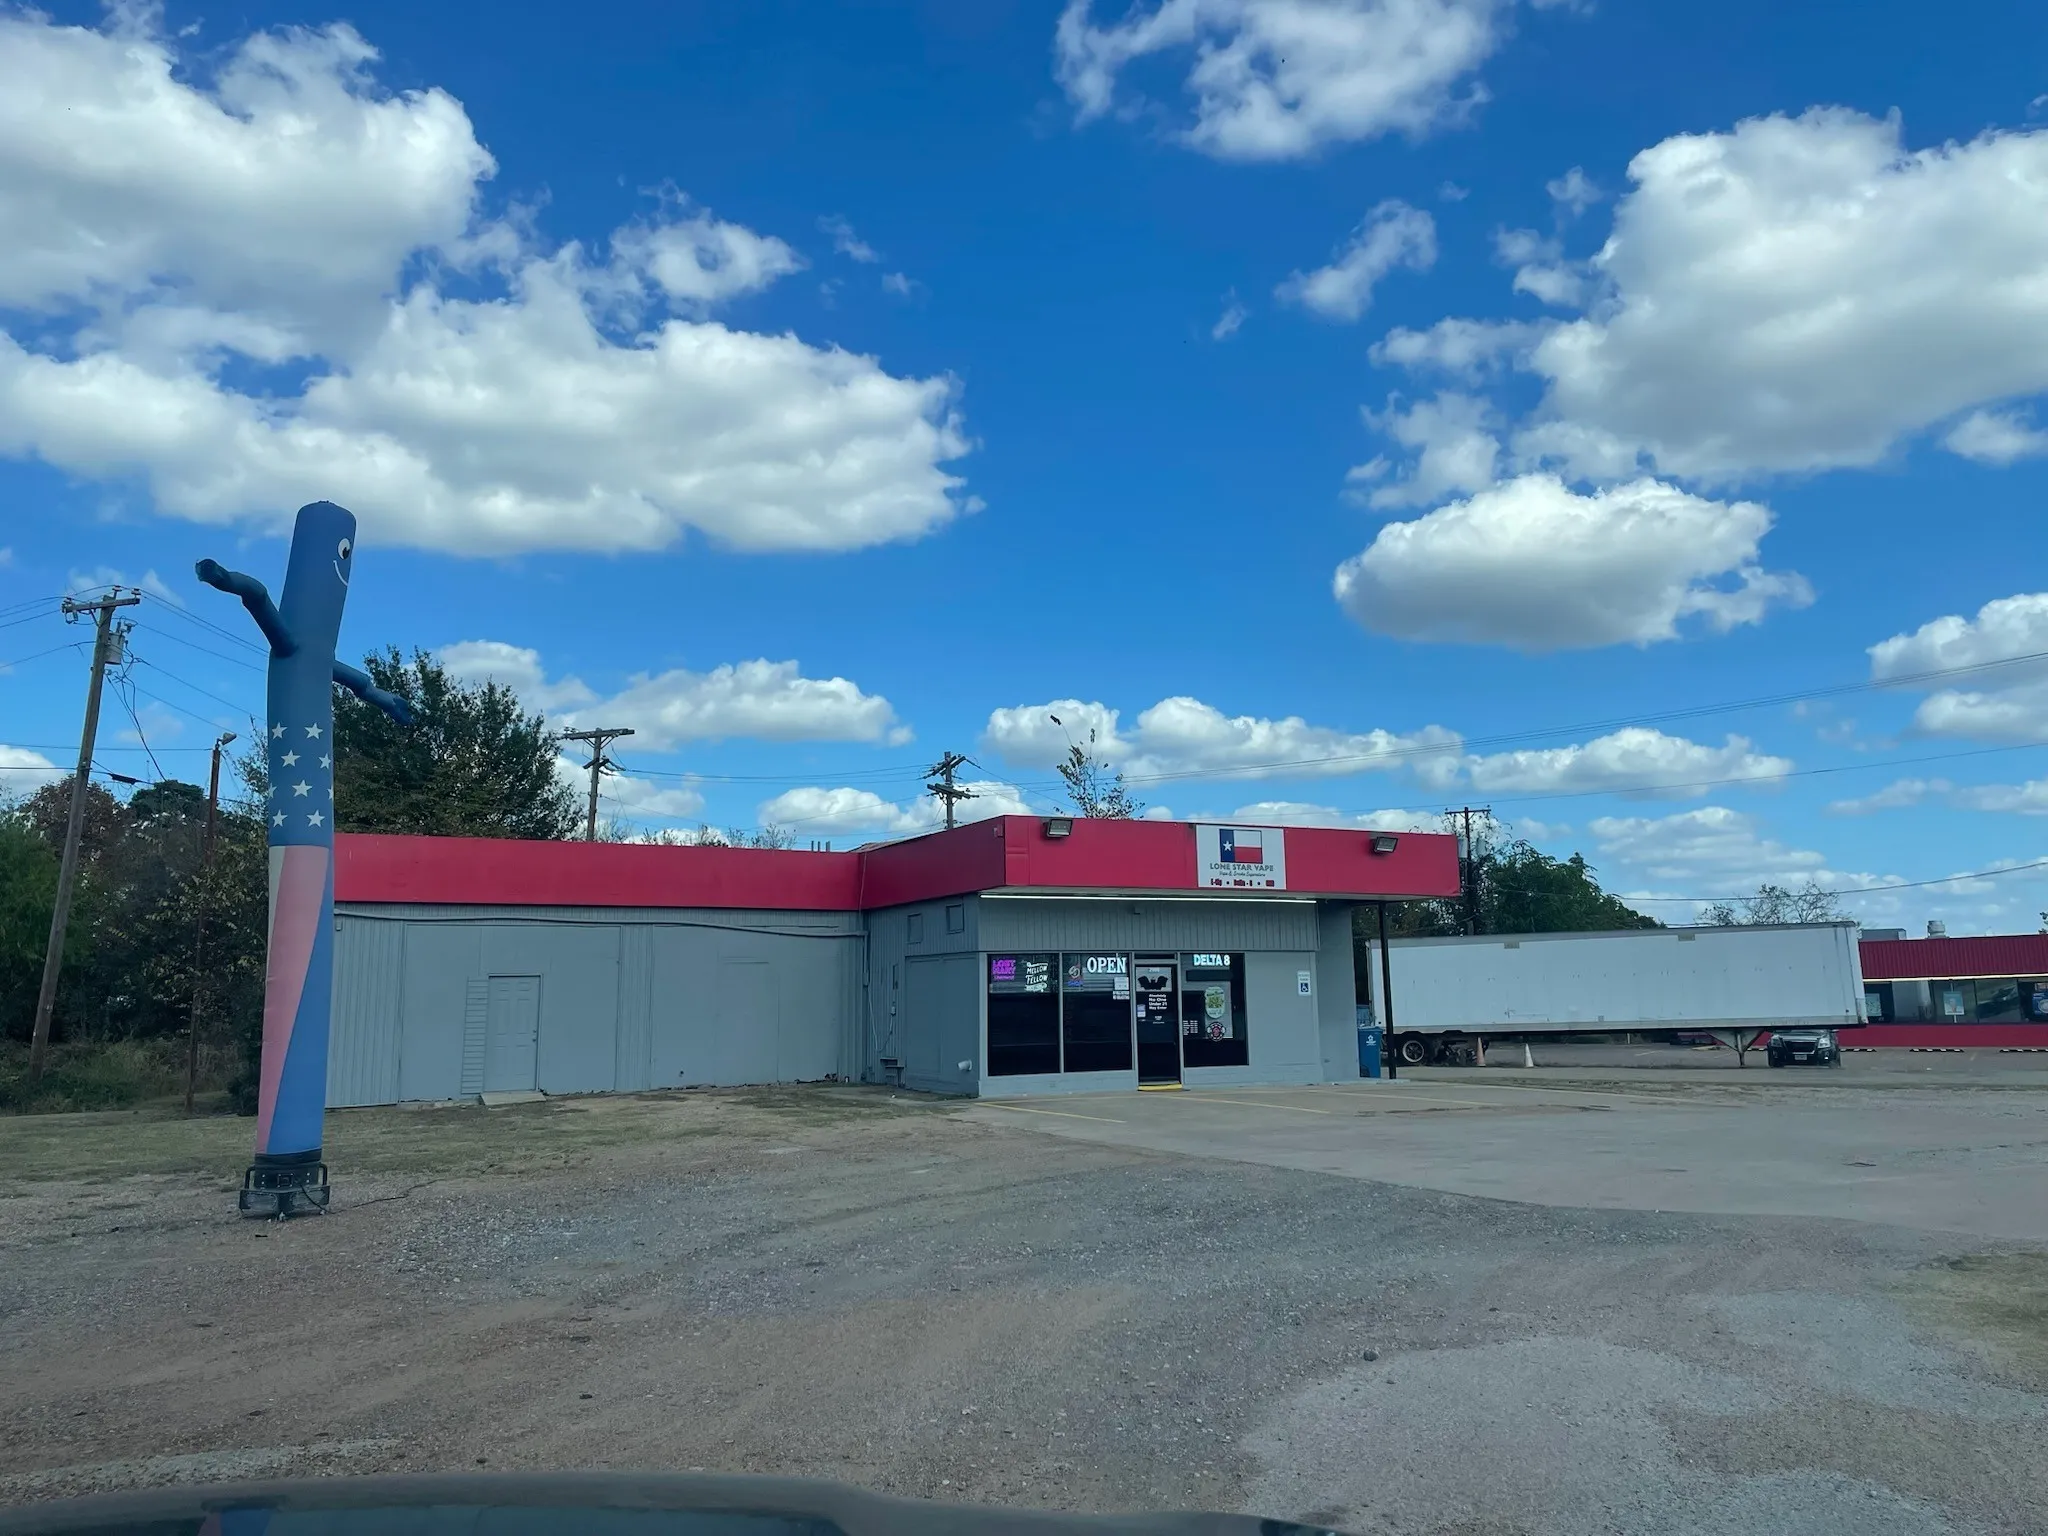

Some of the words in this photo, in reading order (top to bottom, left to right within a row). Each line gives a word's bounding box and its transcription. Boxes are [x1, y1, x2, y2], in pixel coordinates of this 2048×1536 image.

[1087, 957, 1126, 973] OPEN
[1193, 954, 1223, 966] DELTA
[1223, 954, 1231, 966] 8
[1026, 965, 1048, 974] MELLOW
